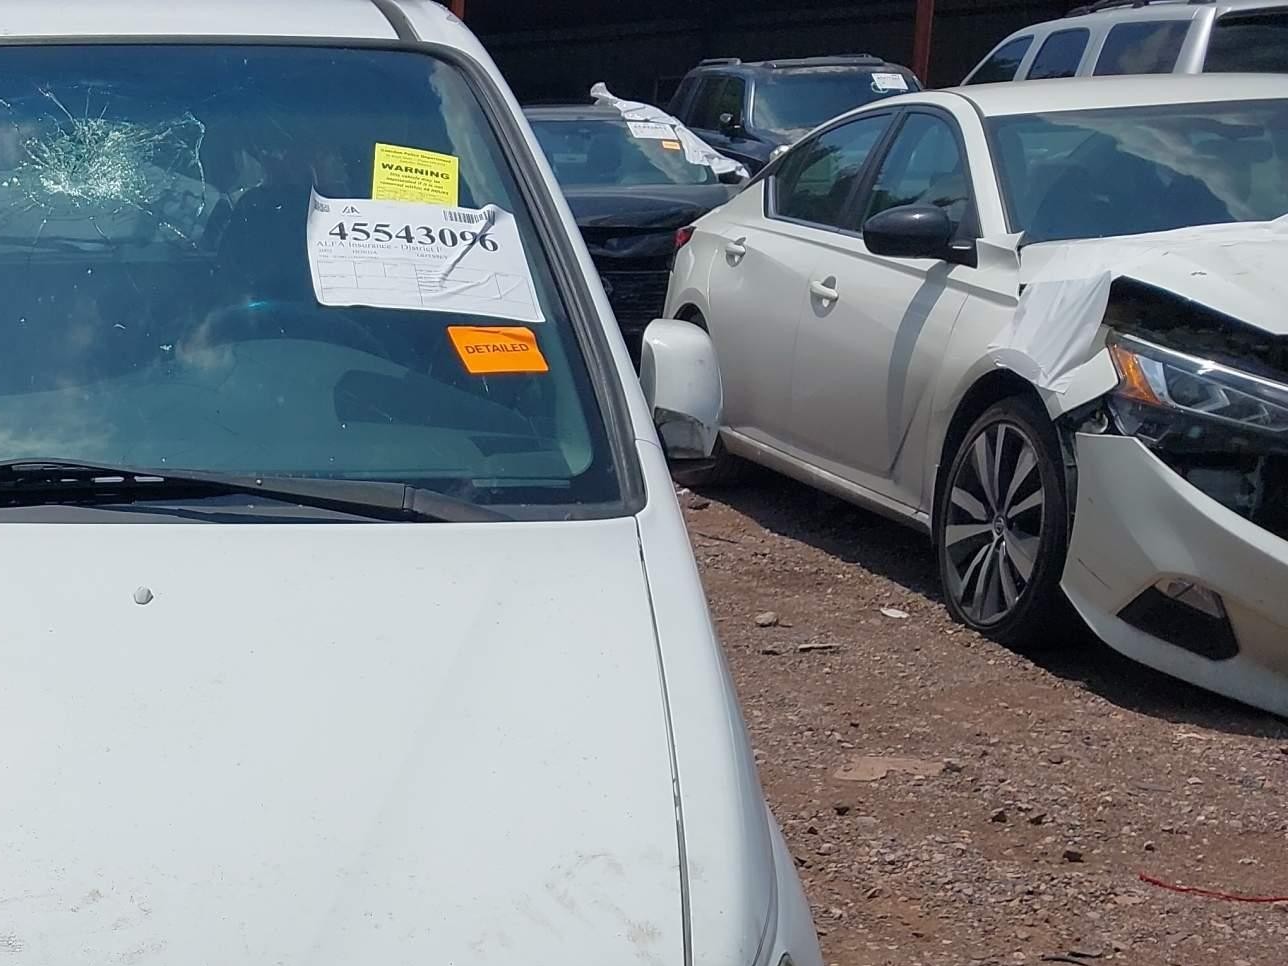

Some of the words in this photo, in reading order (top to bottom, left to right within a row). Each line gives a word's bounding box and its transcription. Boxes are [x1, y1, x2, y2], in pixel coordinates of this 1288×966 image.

[381, 162, 450, 180] WARNING
[329, 222, 498, 251] 45543096
[349, 241, 392, 249] Insurance
[401, 244, 435, 252] District
[464, 343, 530, 354] DETAILED
